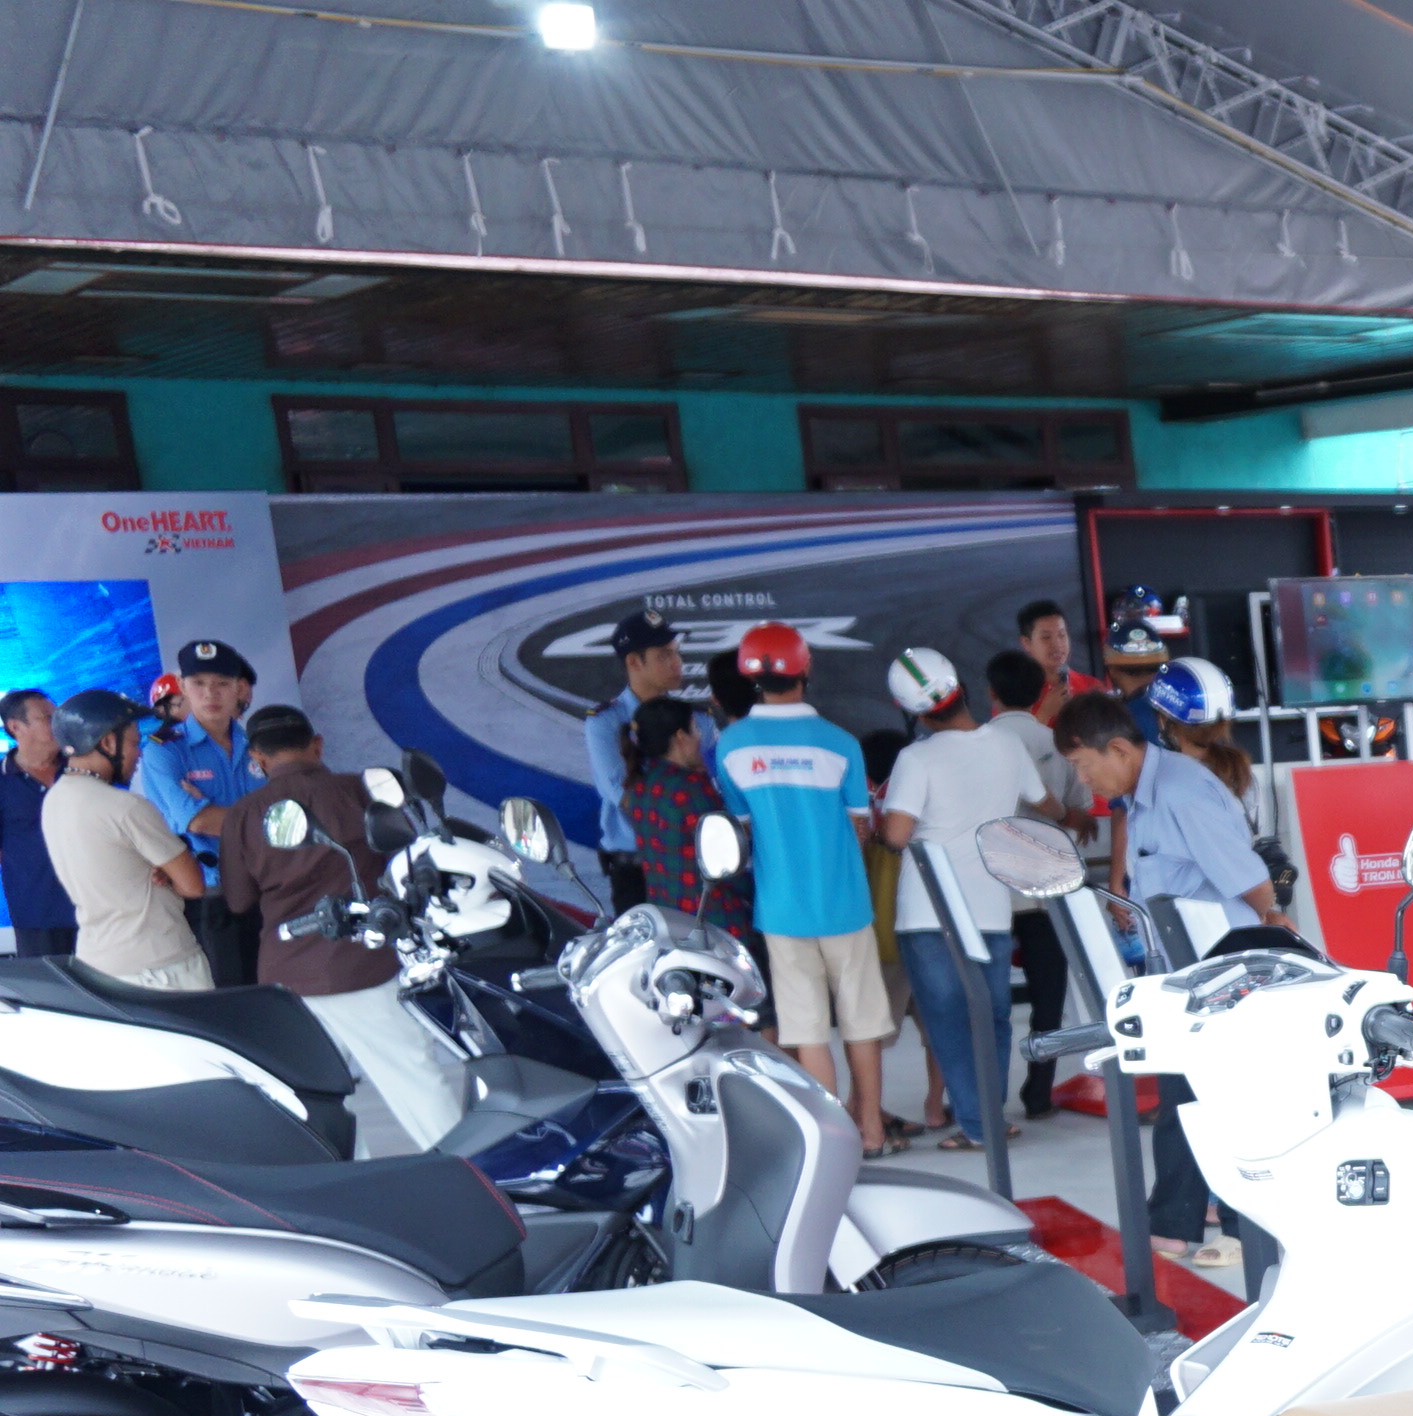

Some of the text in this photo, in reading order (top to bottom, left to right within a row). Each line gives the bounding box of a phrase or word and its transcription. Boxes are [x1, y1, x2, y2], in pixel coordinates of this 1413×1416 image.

[645, 592, 777, 609] TOTAL CONTROL
[1361, 857, 1400, 870] Honda
[1362, 870, 1396, 882] TRON
